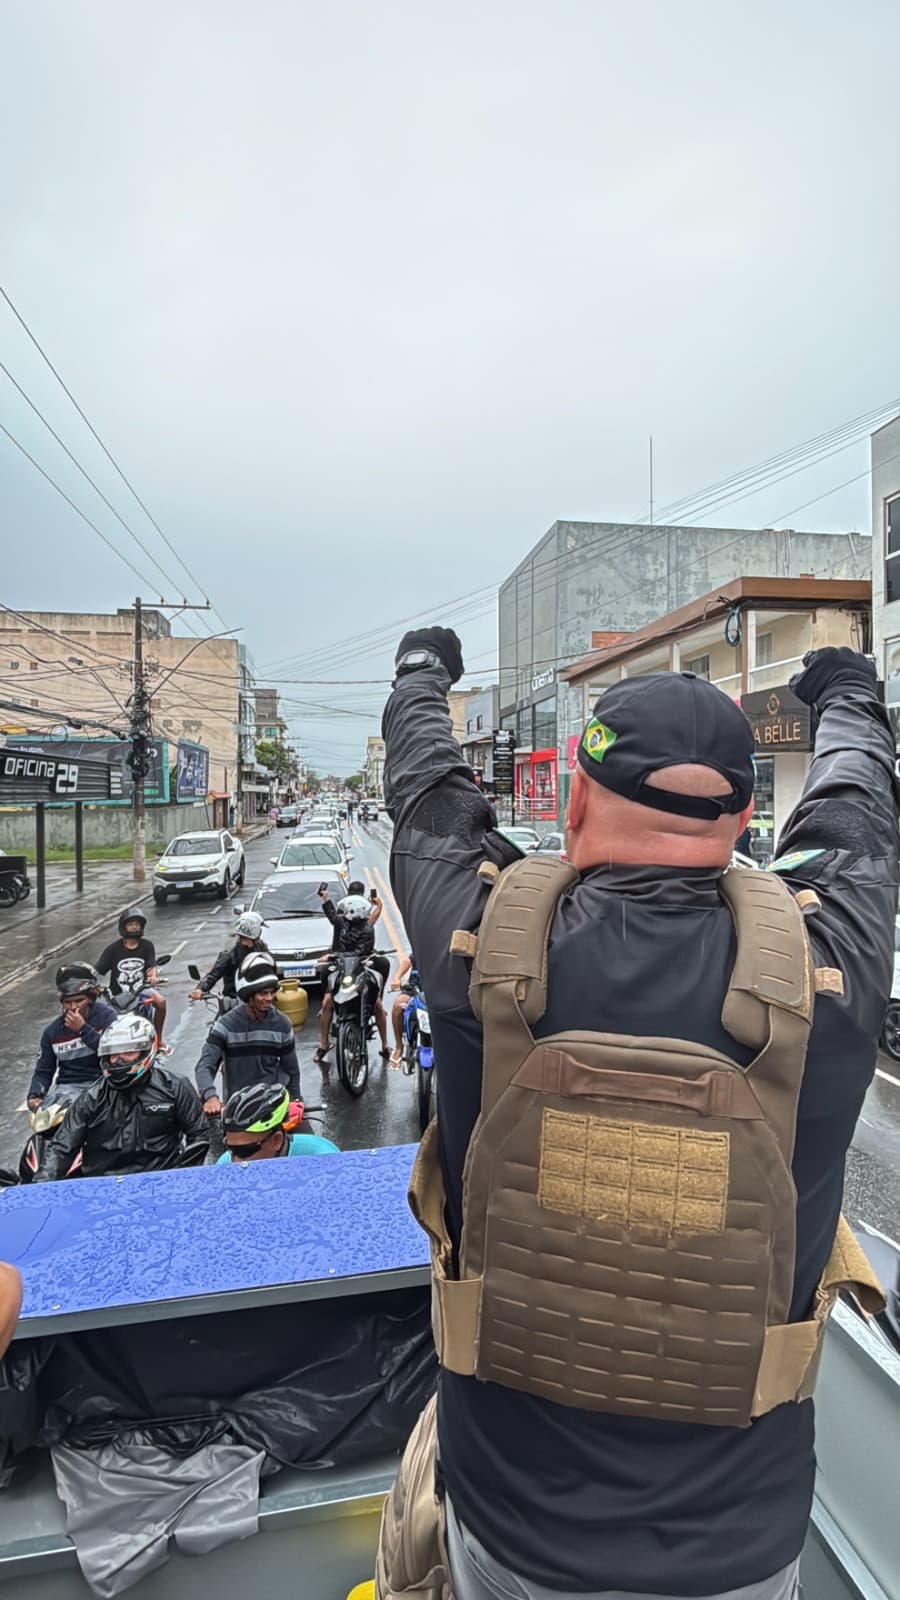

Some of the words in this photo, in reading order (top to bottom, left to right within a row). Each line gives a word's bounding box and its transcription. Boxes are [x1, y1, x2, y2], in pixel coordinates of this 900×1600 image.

[764, 722, 801, 744] BELLE
[55, 763, 80, 794] 29
[57, 1040, 78, 1052] NEW
